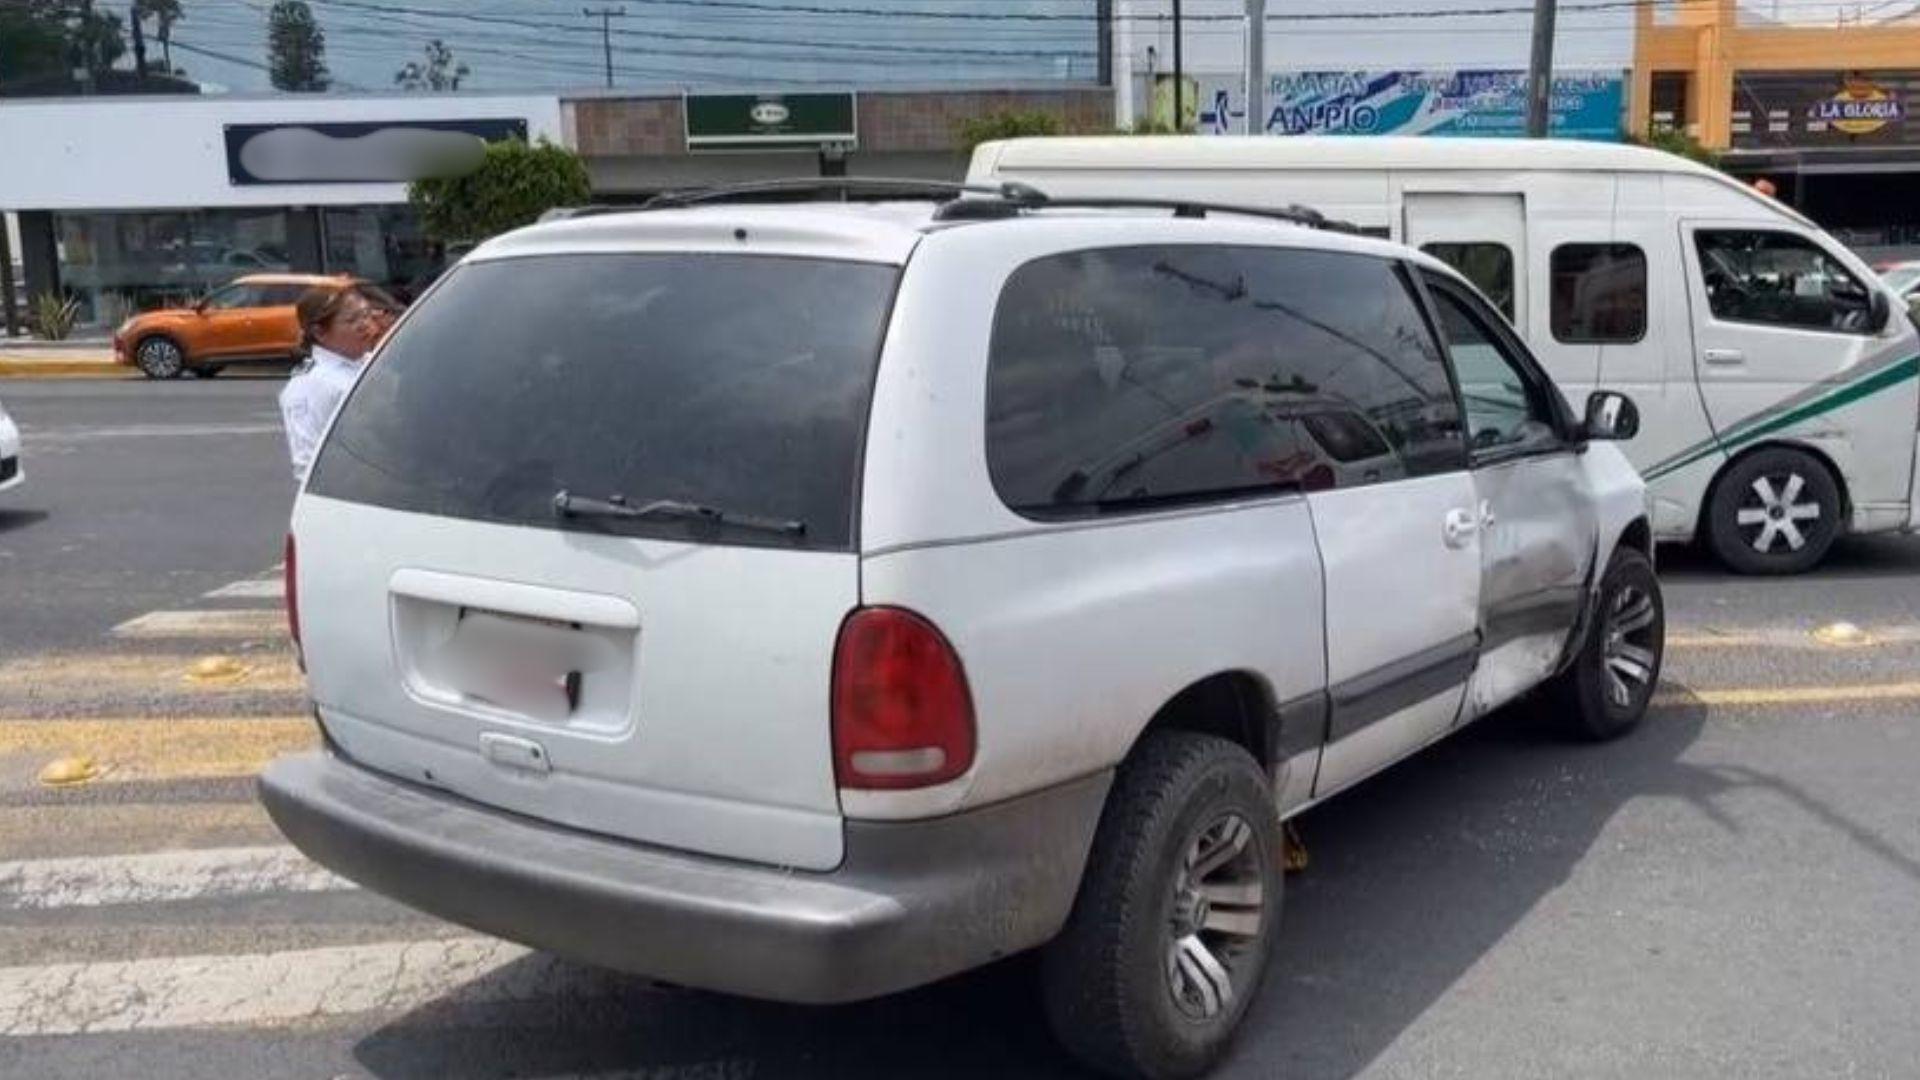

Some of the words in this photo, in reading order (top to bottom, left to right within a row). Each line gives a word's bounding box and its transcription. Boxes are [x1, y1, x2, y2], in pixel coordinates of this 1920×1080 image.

[1266, 105, 1313, 131] AN
[1820, 102, 1840, 118] LA
[1843, 102, 1898, 118] GLORIA
